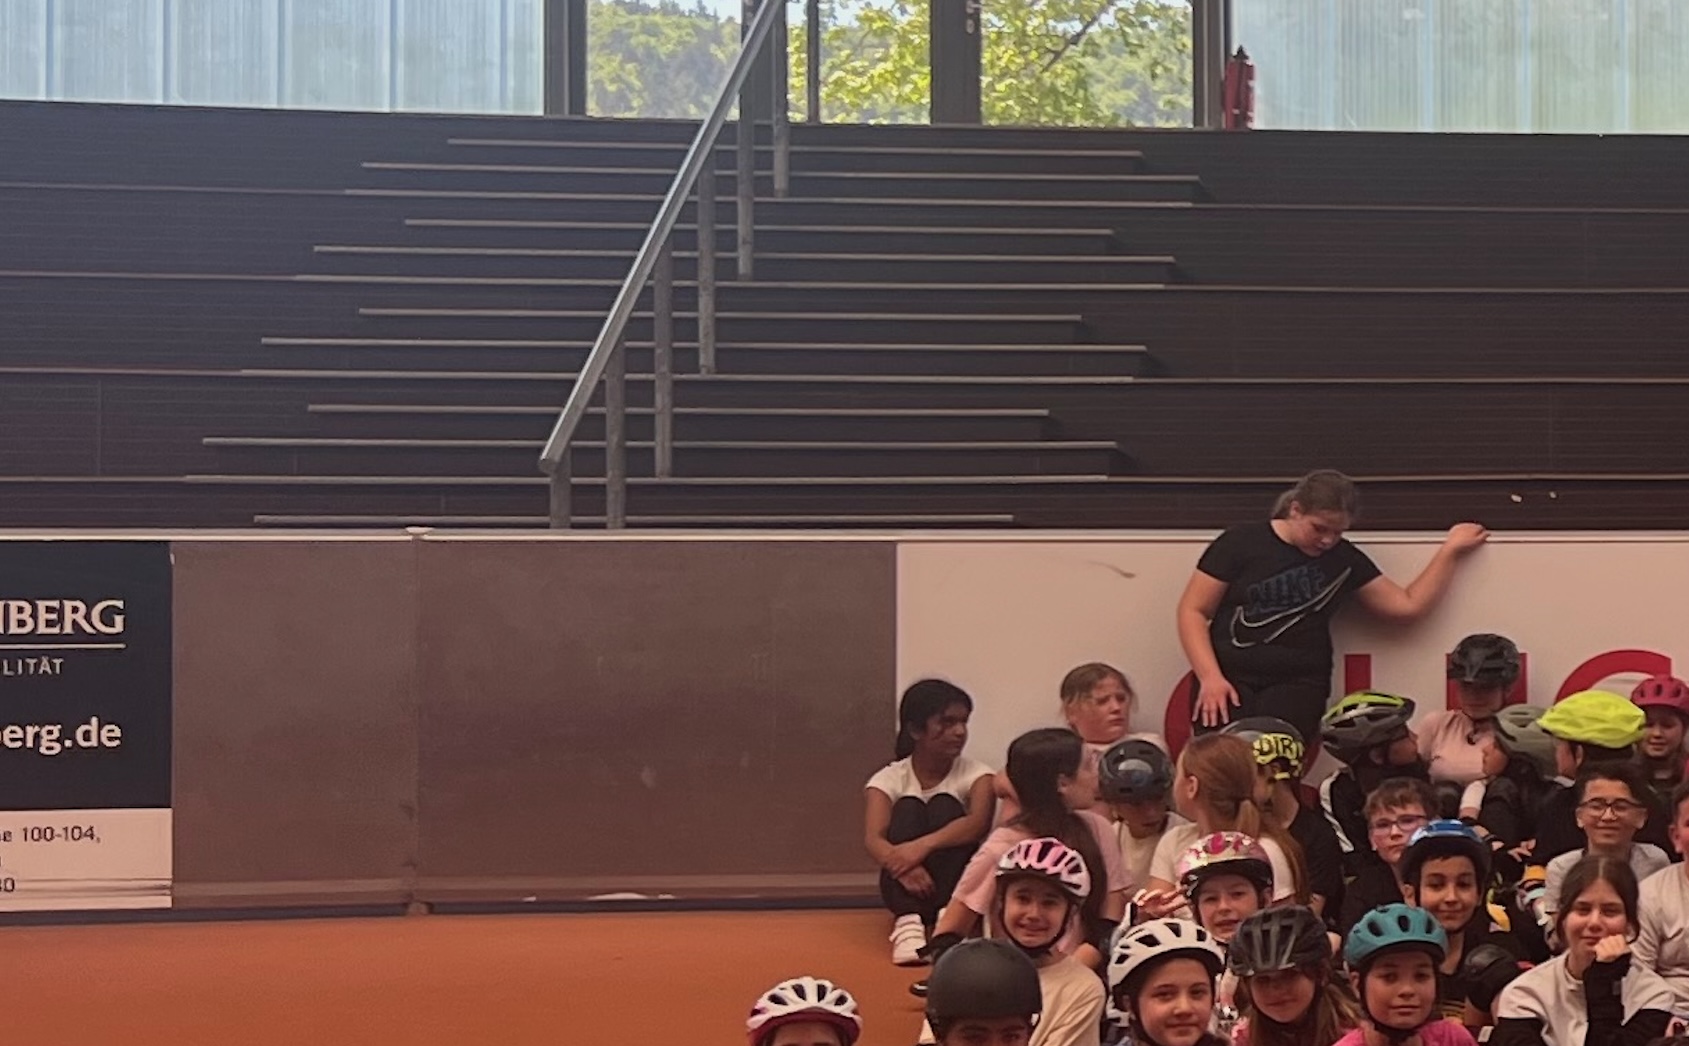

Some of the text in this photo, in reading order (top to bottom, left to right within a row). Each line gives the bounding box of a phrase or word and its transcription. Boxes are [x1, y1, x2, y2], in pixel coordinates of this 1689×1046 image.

[0, 599, 126, 635] BERG
[0, 715, 122, 756] erg.de
[22, 825, 101, 843] 100-104,
